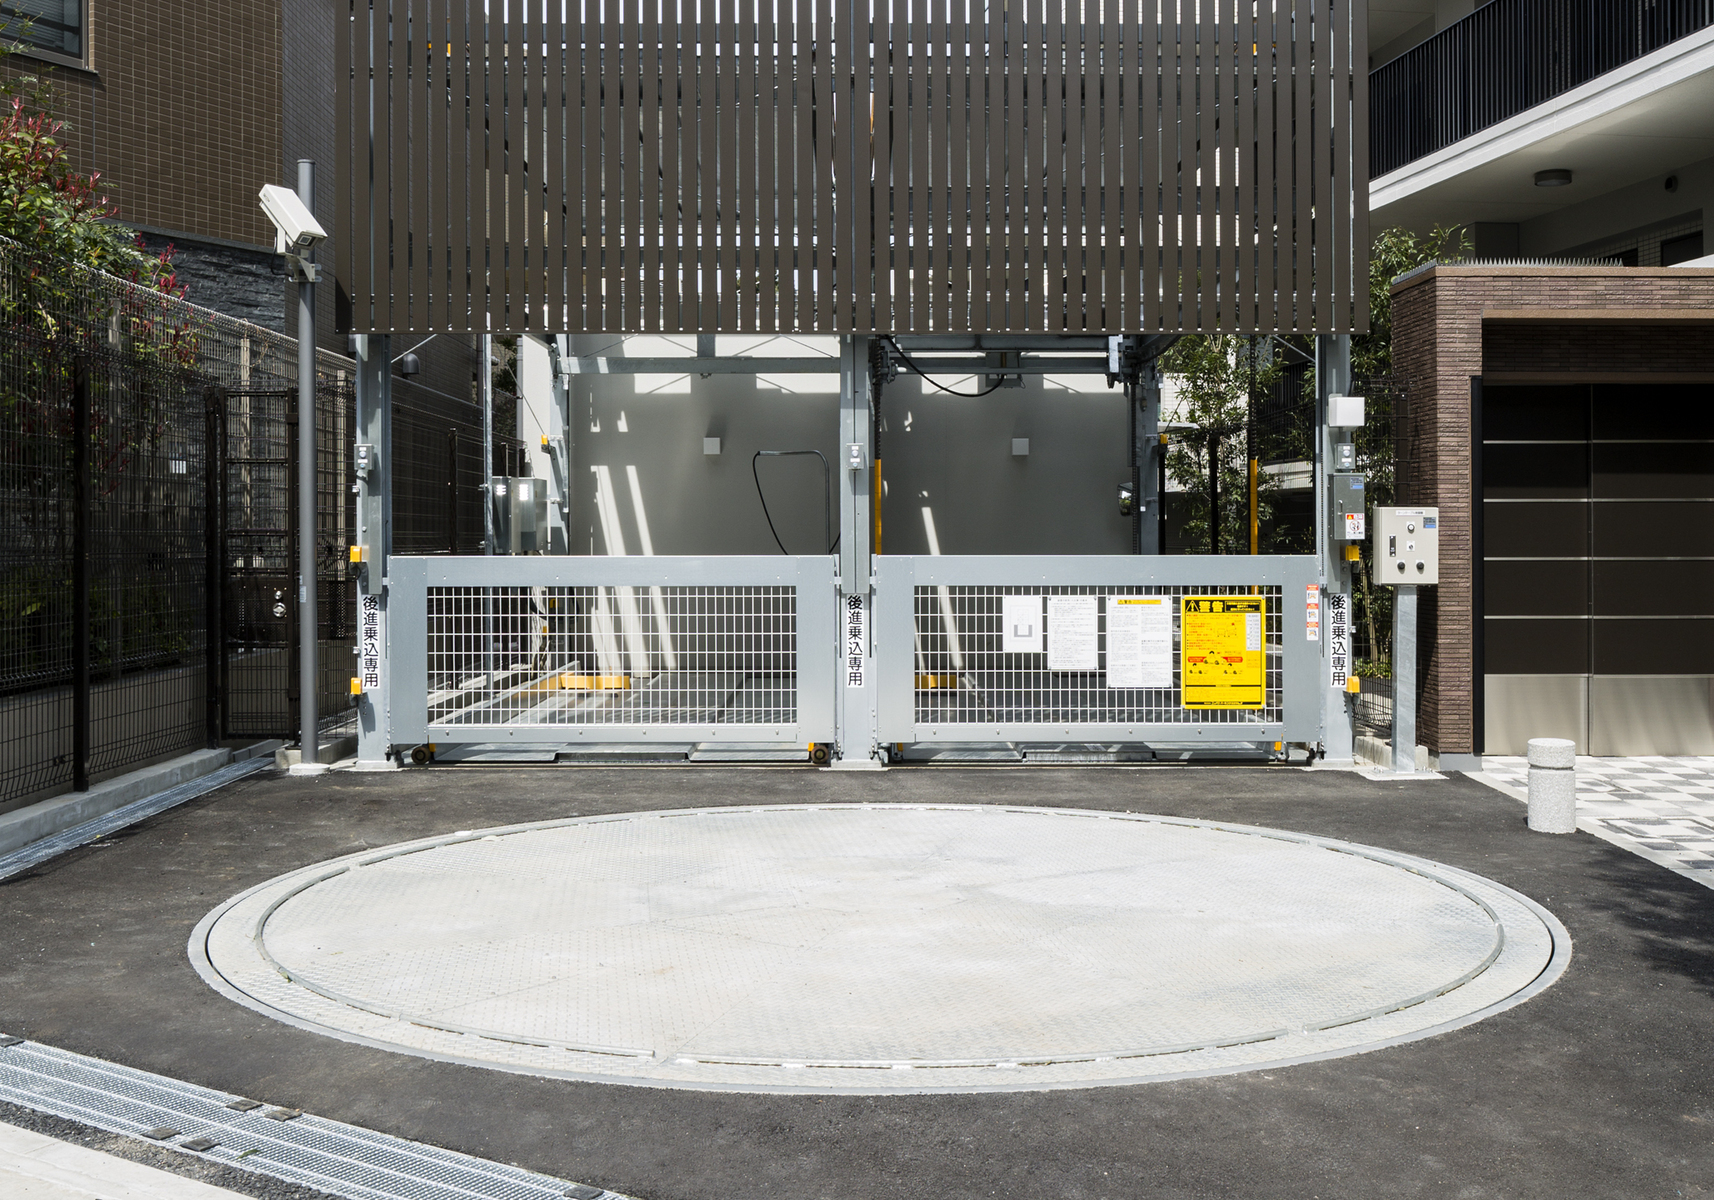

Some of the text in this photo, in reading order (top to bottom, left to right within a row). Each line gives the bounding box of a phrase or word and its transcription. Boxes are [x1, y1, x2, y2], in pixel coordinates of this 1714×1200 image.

[363, 596, 378, 687] 後進乗込専用
[848, 595, 863, 686] 後進乗込専用
[1198, 600, 1224, 613] 警告
[1331, 595, 1346, 686] 後進乗込専用
